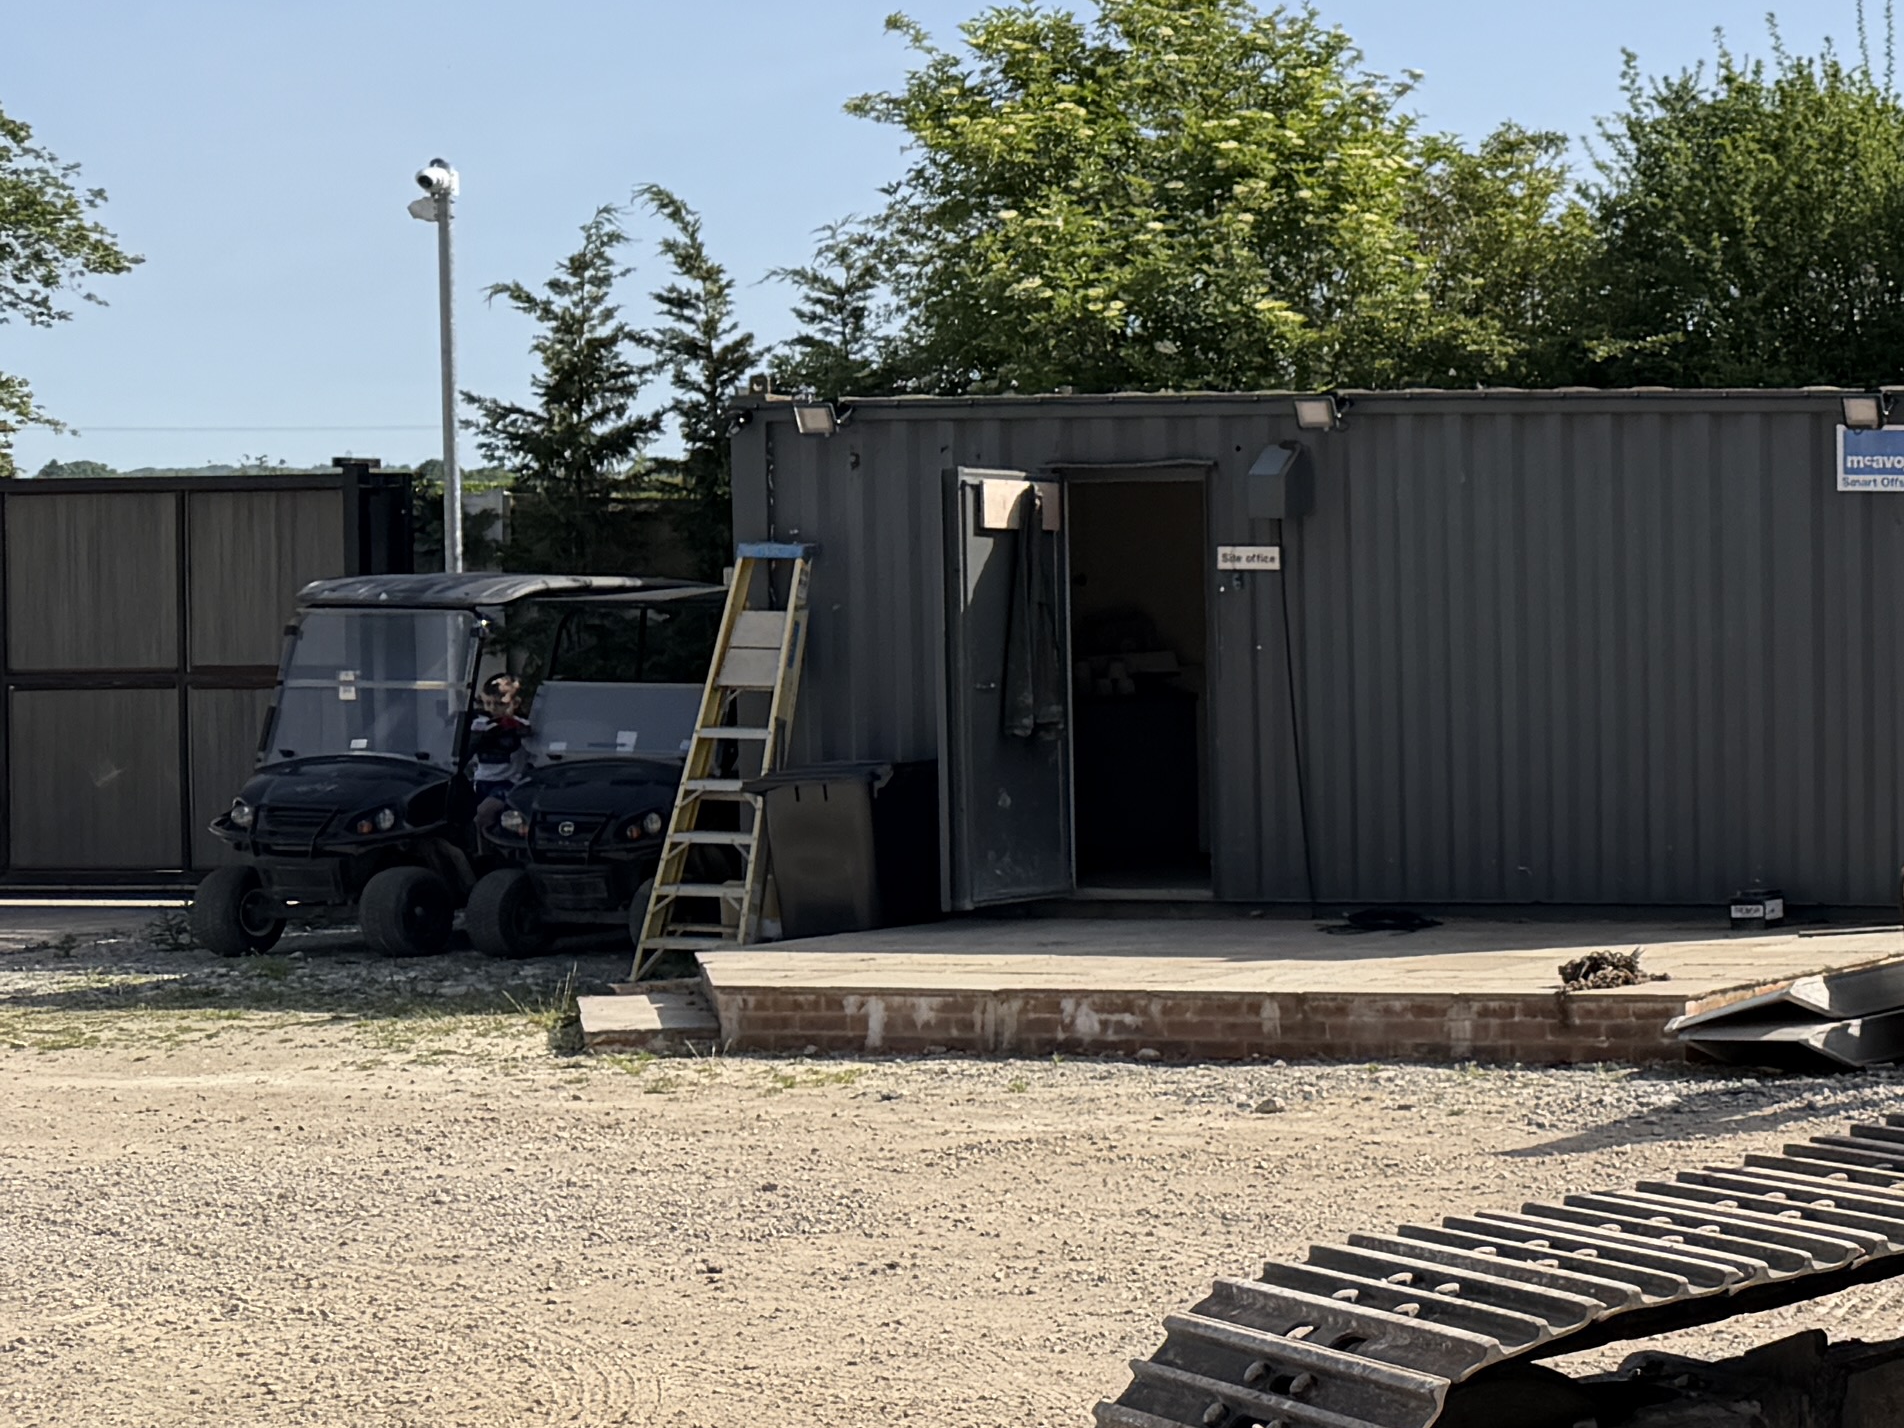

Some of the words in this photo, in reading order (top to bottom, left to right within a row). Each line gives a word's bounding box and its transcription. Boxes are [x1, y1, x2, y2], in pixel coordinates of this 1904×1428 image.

[1842, 476, 1877, 488] Smart
[1221, 552, 1242, 564] Site
[1245, 553, 1276, 564] office
